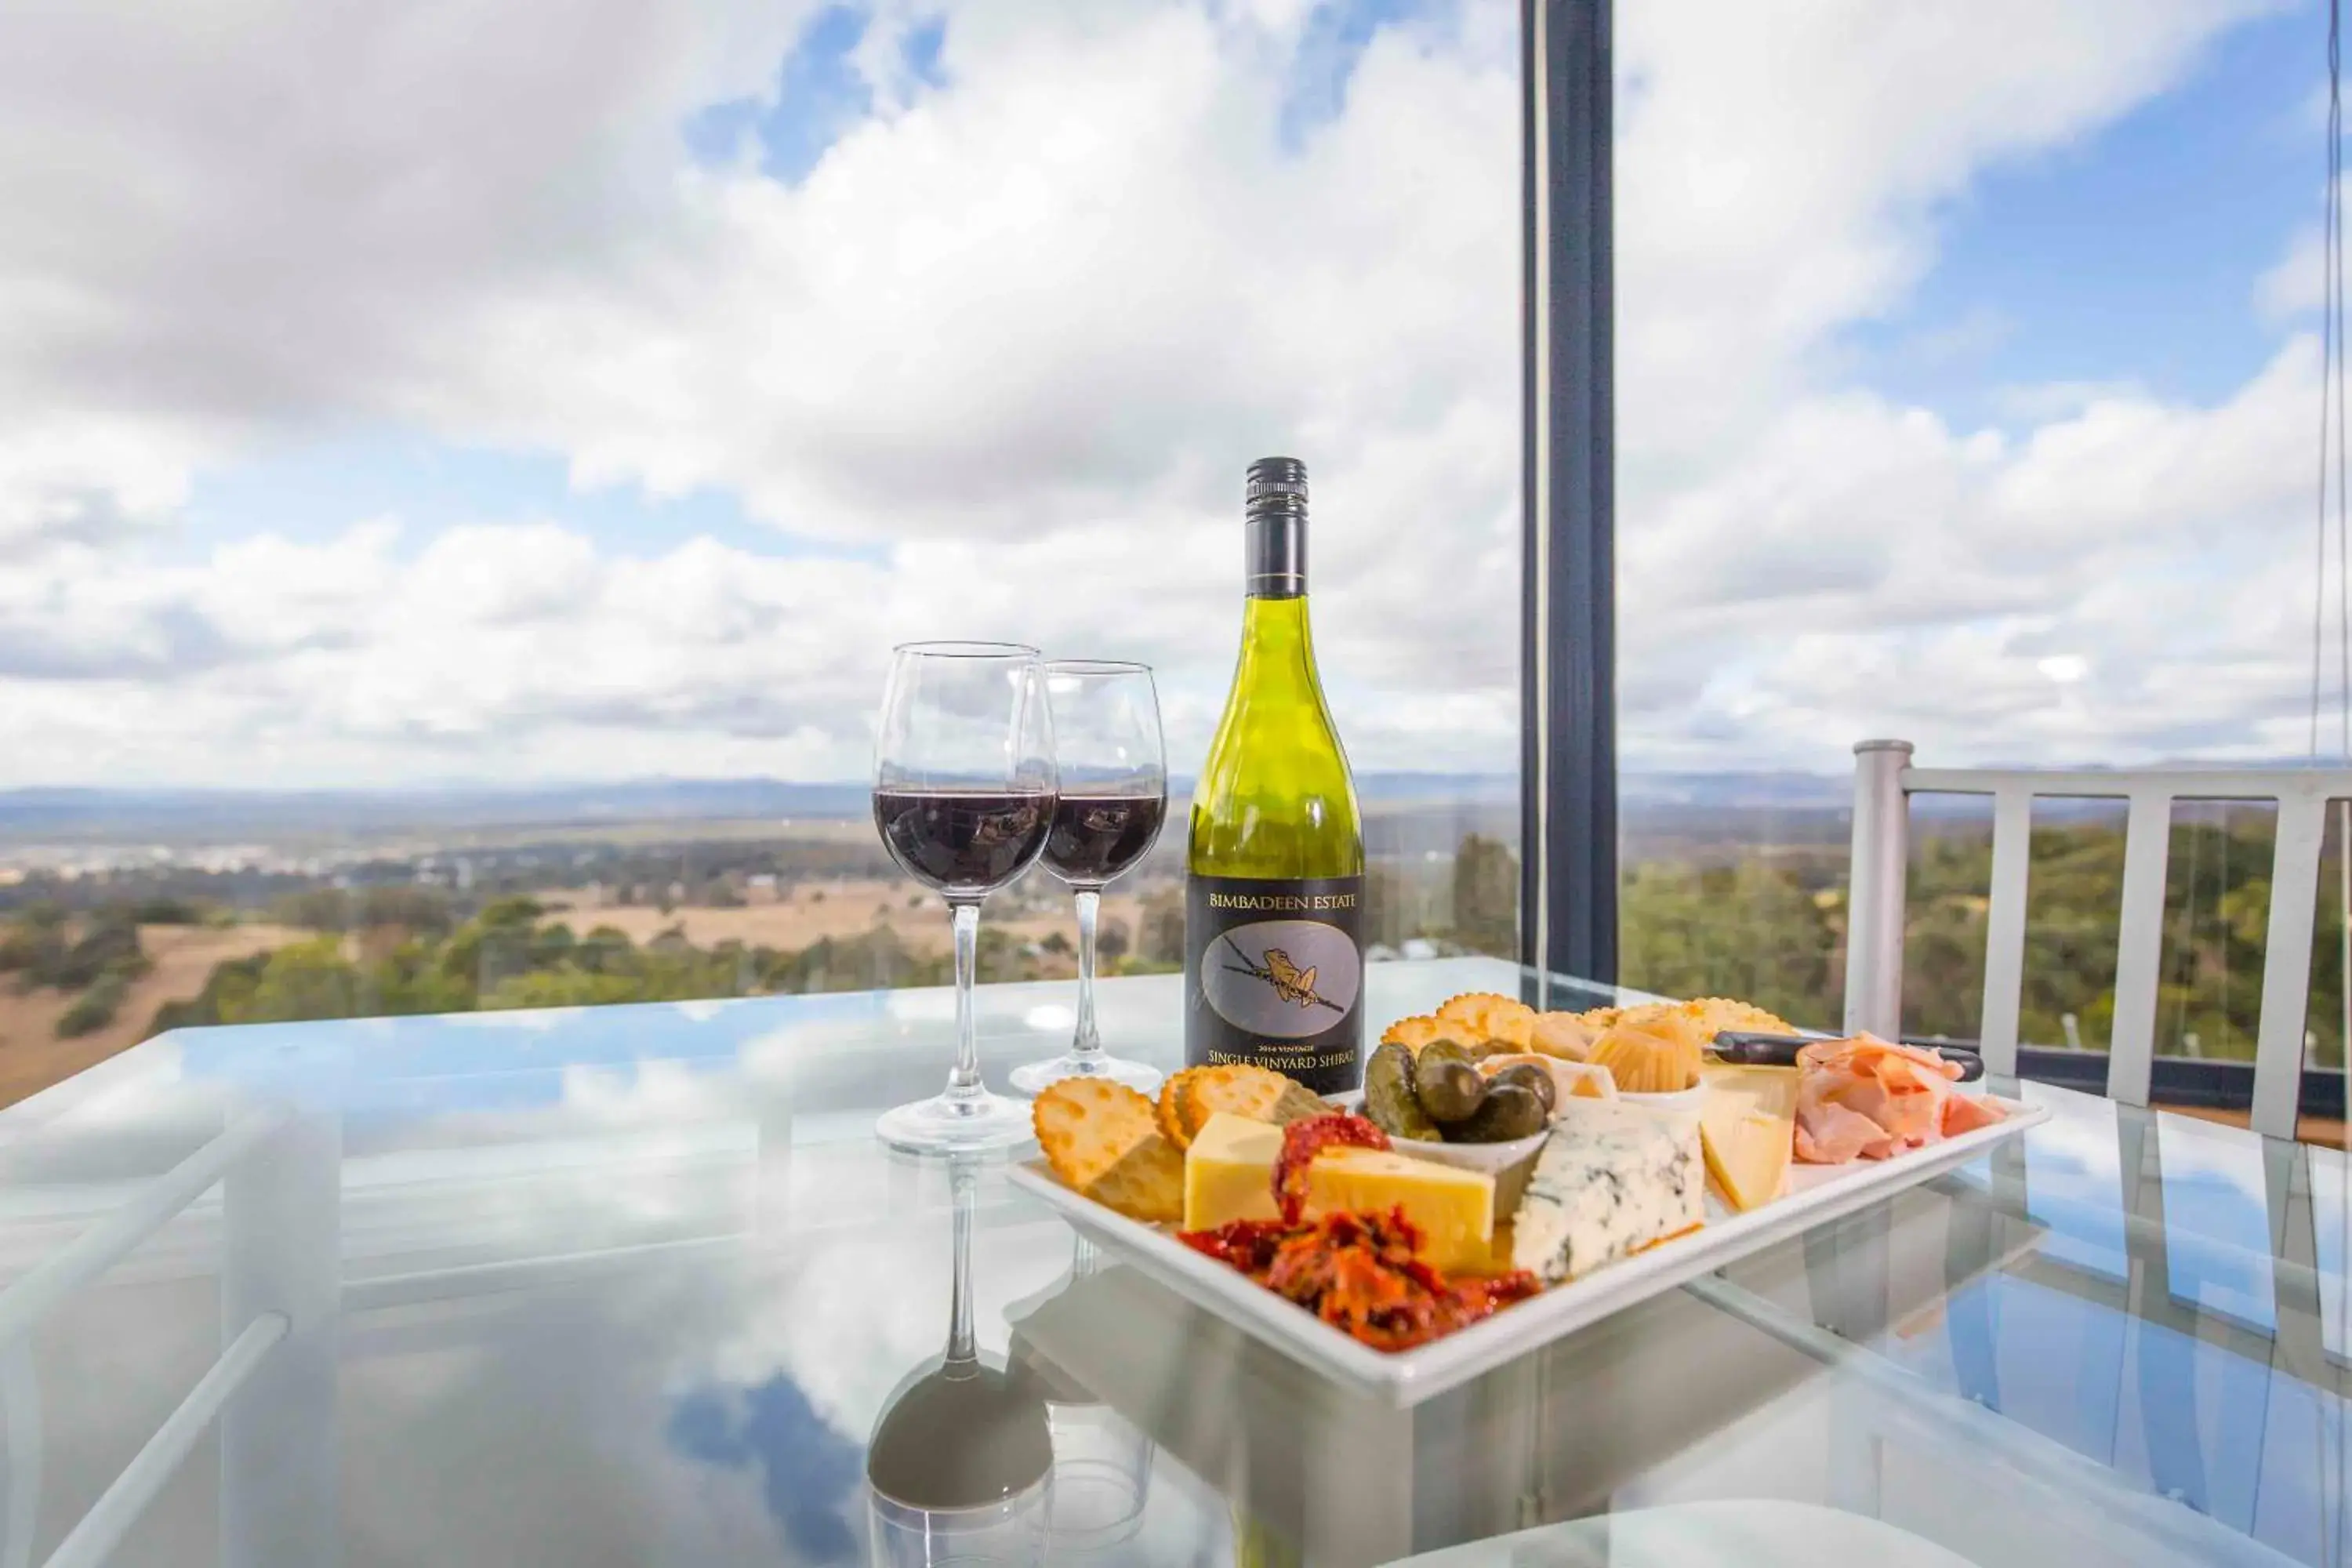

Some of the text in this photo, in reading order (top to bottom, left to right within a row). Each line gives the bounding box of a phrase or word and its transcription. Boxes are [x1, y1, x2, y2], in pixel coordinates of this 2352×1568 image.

[1209, 893, 1356, 909] BIMBADEEN ESTATE
[1278, 1044, 1315, 1053] VINTAGE
[1208, 1049, 1355, 1070] SINGLE VINYARD SHIRAZ
